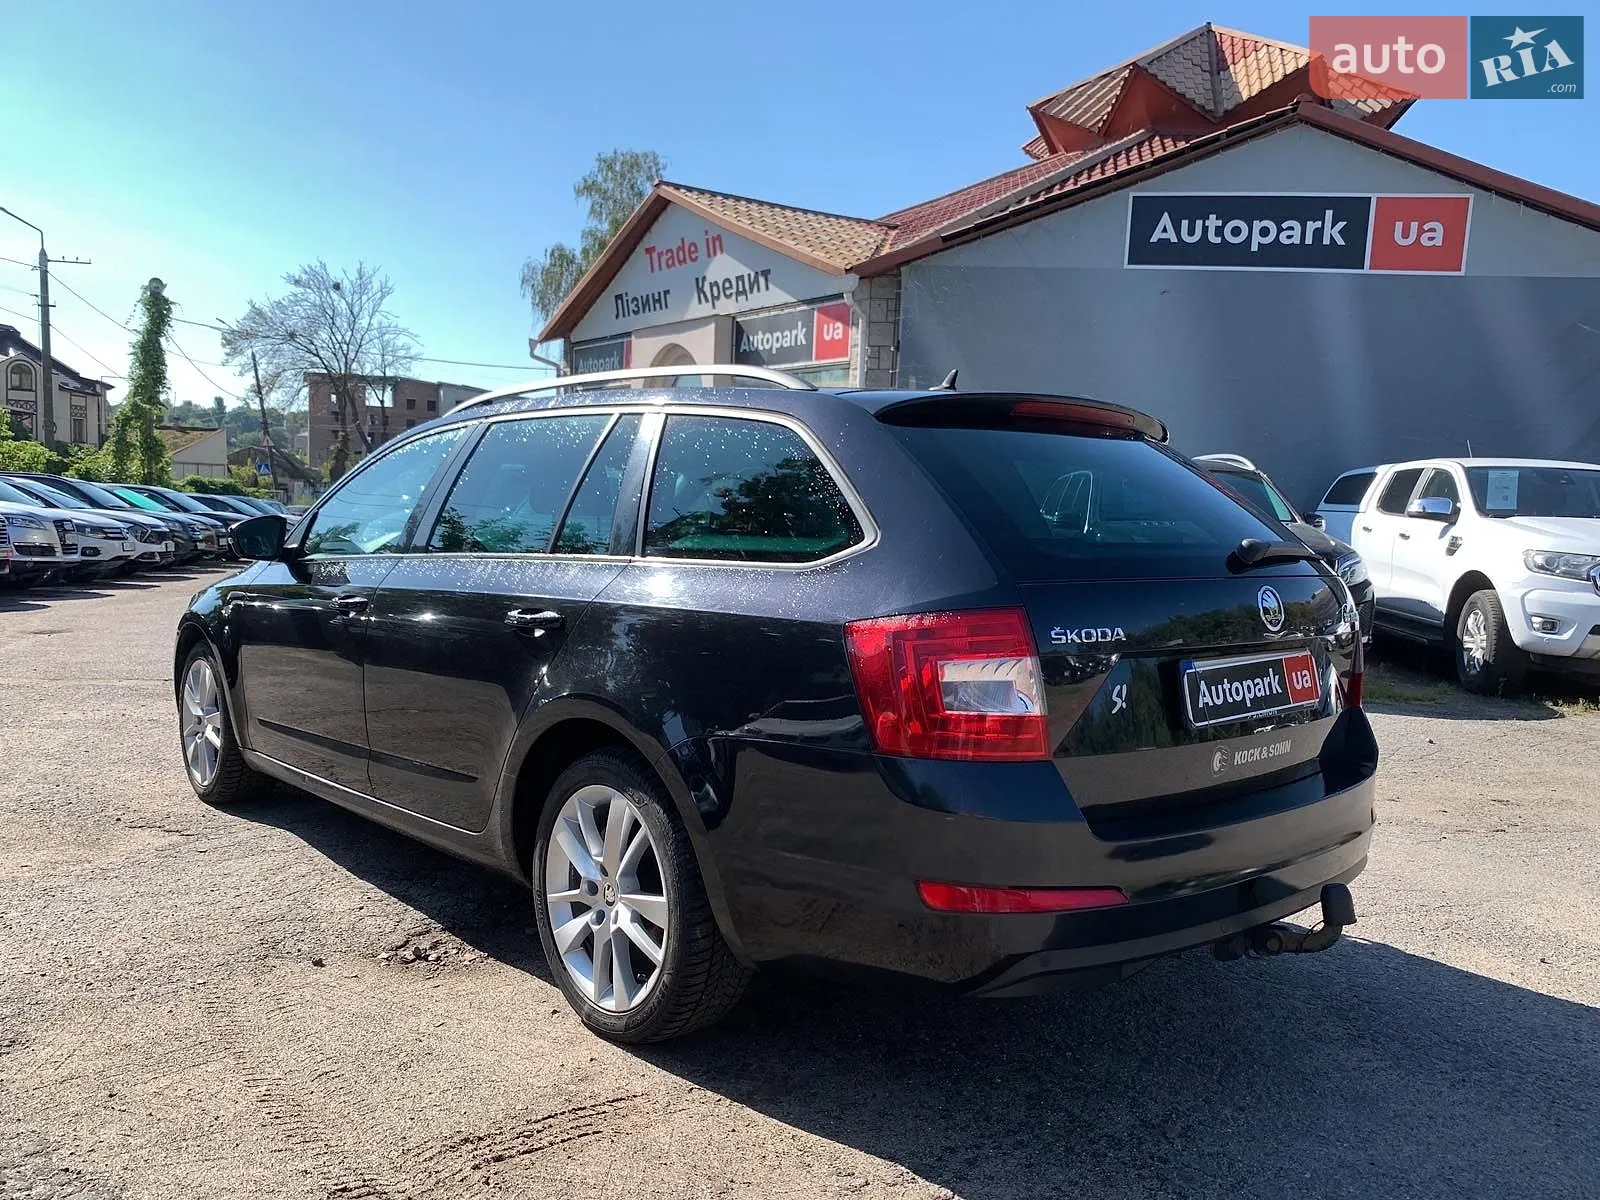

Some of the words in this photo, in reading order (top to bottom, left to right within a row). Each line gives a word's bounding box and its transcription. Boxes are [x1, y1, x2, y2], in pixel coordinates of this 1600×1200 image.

[1150, 210, 1348, 252] Autopark
[1394, 219, 1445, 247] ua
[645, 236, 699, 274] Trade
[704, 229, 725, 259] in
[614, 289, 671, 321] Лізинг
[696, 268, 772, 310] Кредит
[740, 322, 807, 355] Autopark
[823, 321, 844, 342] ua
[578, 351, 620, 374] Autopark
[1050, 626, 1127, 645] ŠKODA
[1198, 667, 1282, 708] Autopark
[1292, 669, 1312, 690] ua
